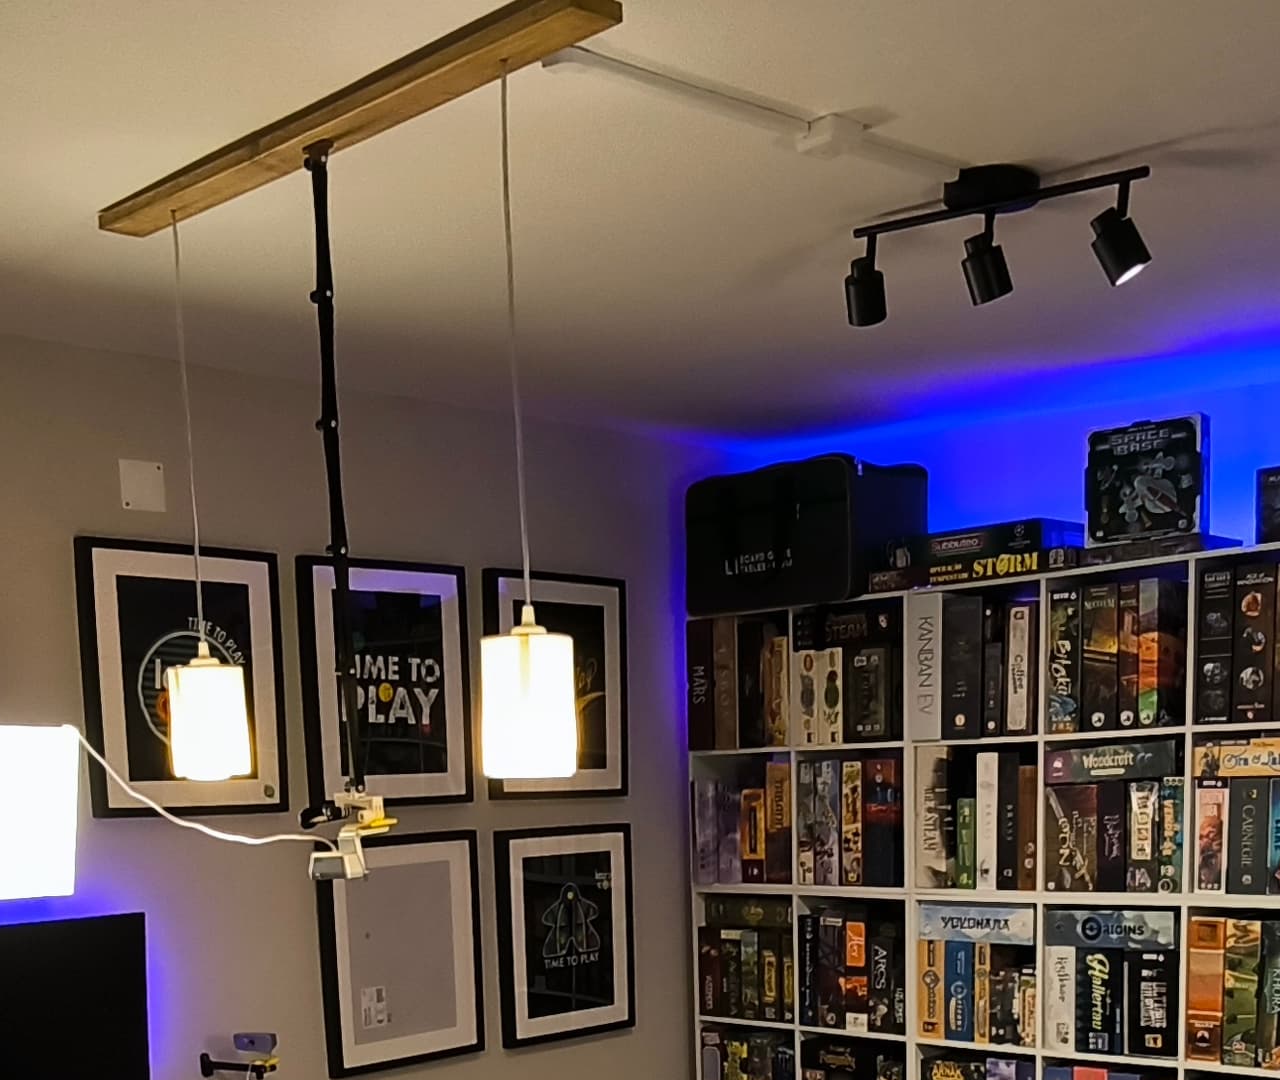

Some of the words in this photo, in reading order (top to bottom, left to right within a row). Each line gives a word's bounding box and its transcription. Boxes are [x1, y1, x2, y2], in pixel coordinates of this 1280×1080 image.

[352, 654, 400, 681] IME
[408, 657, 440, 684] TO
[917, 615, 936, 688] KANBAN
[1082, 751, 1134, 770] Woodcraft
[544, 957, 565, 968] TIME
[567, 955, 579, 966] TO
[580, 952, 600, 964] PLAY
[874, 945, 888, 990] ARCS
[1086, 953, 1111, 1031] Hallertau
